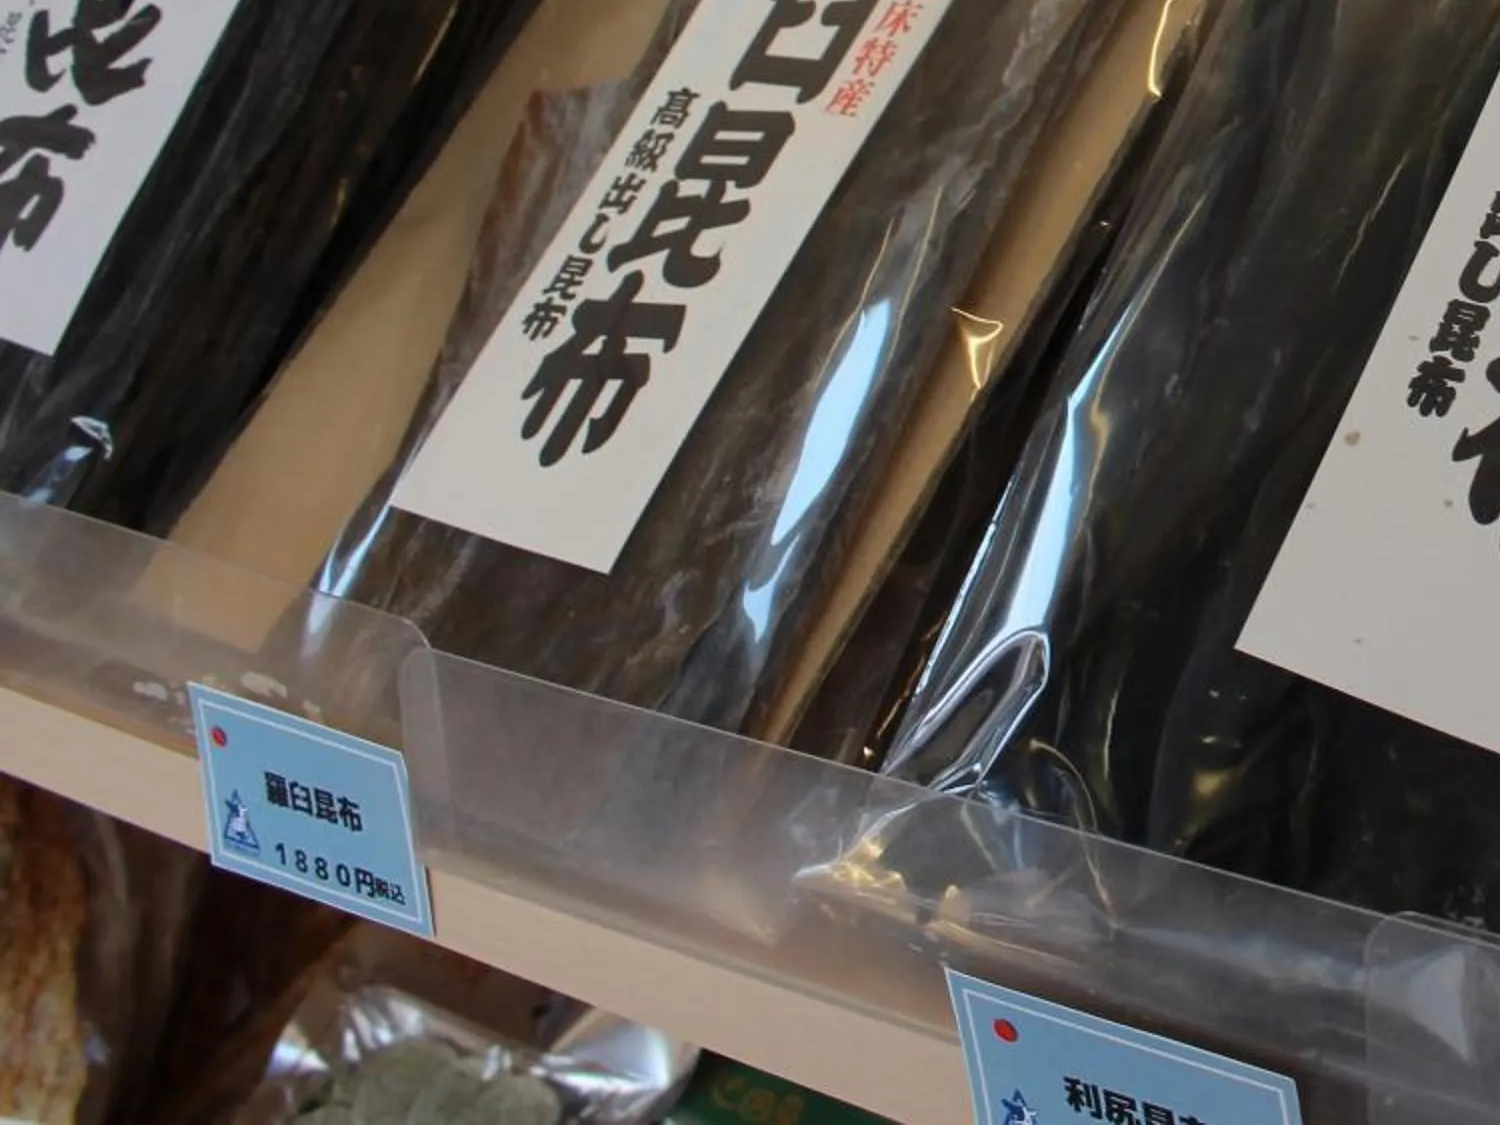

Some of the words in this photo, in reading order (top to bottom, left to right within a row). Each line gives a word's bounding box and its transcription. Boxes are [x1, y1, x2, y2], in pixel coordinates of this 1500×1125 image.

[264, 771, 363, 832] 羅臼昆布
[1063, 1076, 1208, 1125] 利尻昆
